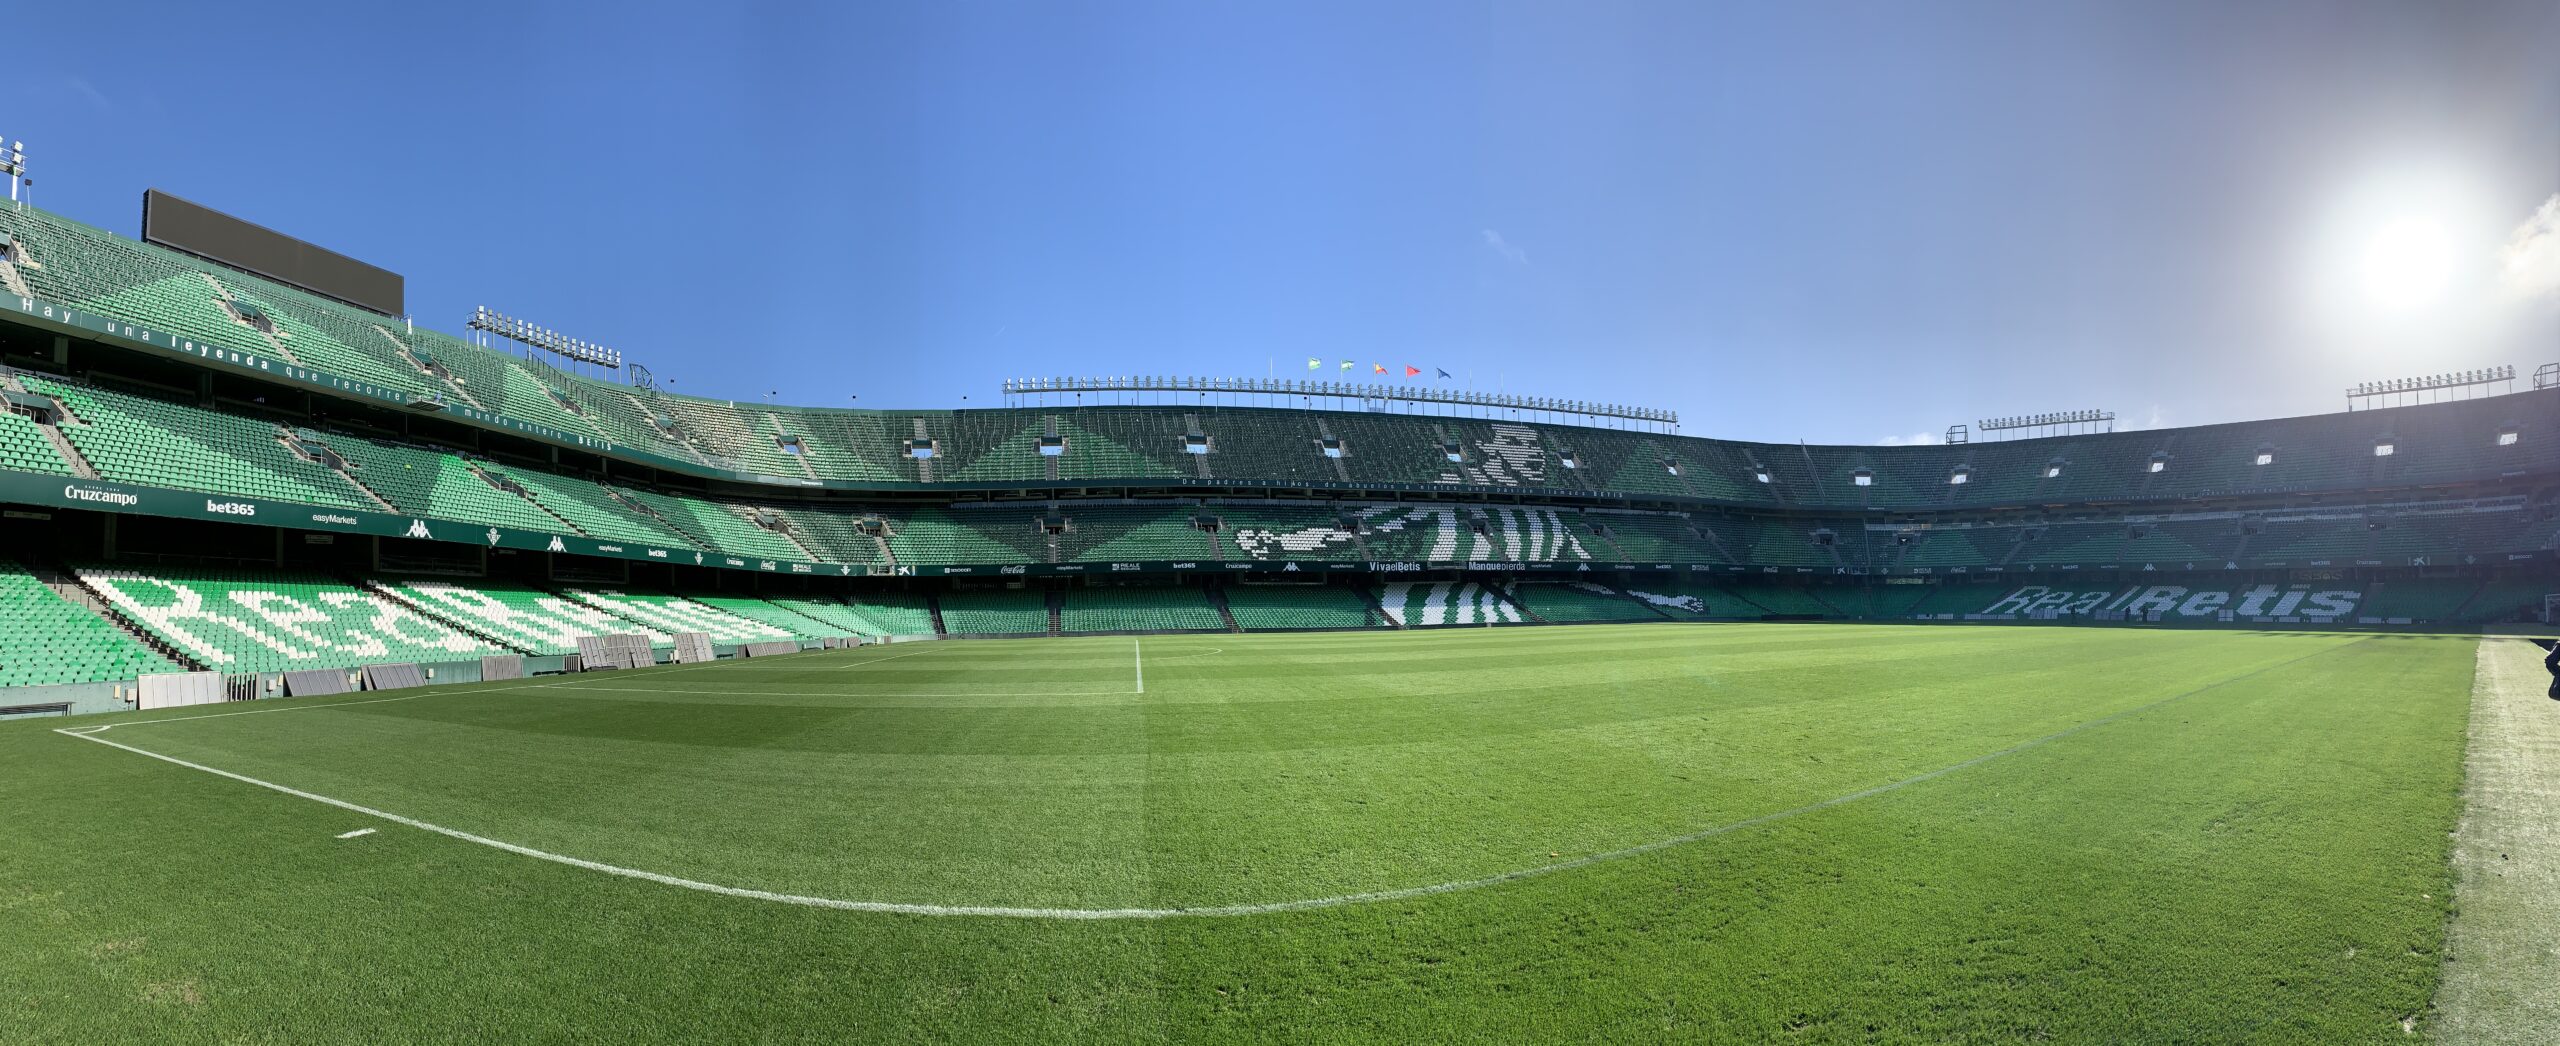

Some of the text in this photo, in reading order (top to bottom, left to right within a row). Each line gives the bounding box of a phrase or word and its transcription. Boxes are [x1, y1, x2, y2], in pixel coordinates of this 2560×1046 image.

[22, 297, 71, 323] Hay
[107, 321, 150, 341] una
[171, 335, 268, 370] leyenda
[286, 365, 318, 382] que
[333, 377, 400, 401] recorre
[464, 408, 508, 426] mundo
[578, 435, 612, 451] BETIS
[1182, 478, 1196, 486] De
[1207, 478, 1252, 487] padres
[65, 485, 138, 506] Cruzcampo
[207, 499, 255, 516] bet365
[312, 514, 358, 525] easyMarkets
[648, 549, 668, 558] bet365
[1001, 565, 1027, 574] Coca-Cola
[1980, 583, 2362, 617] Real Betis
